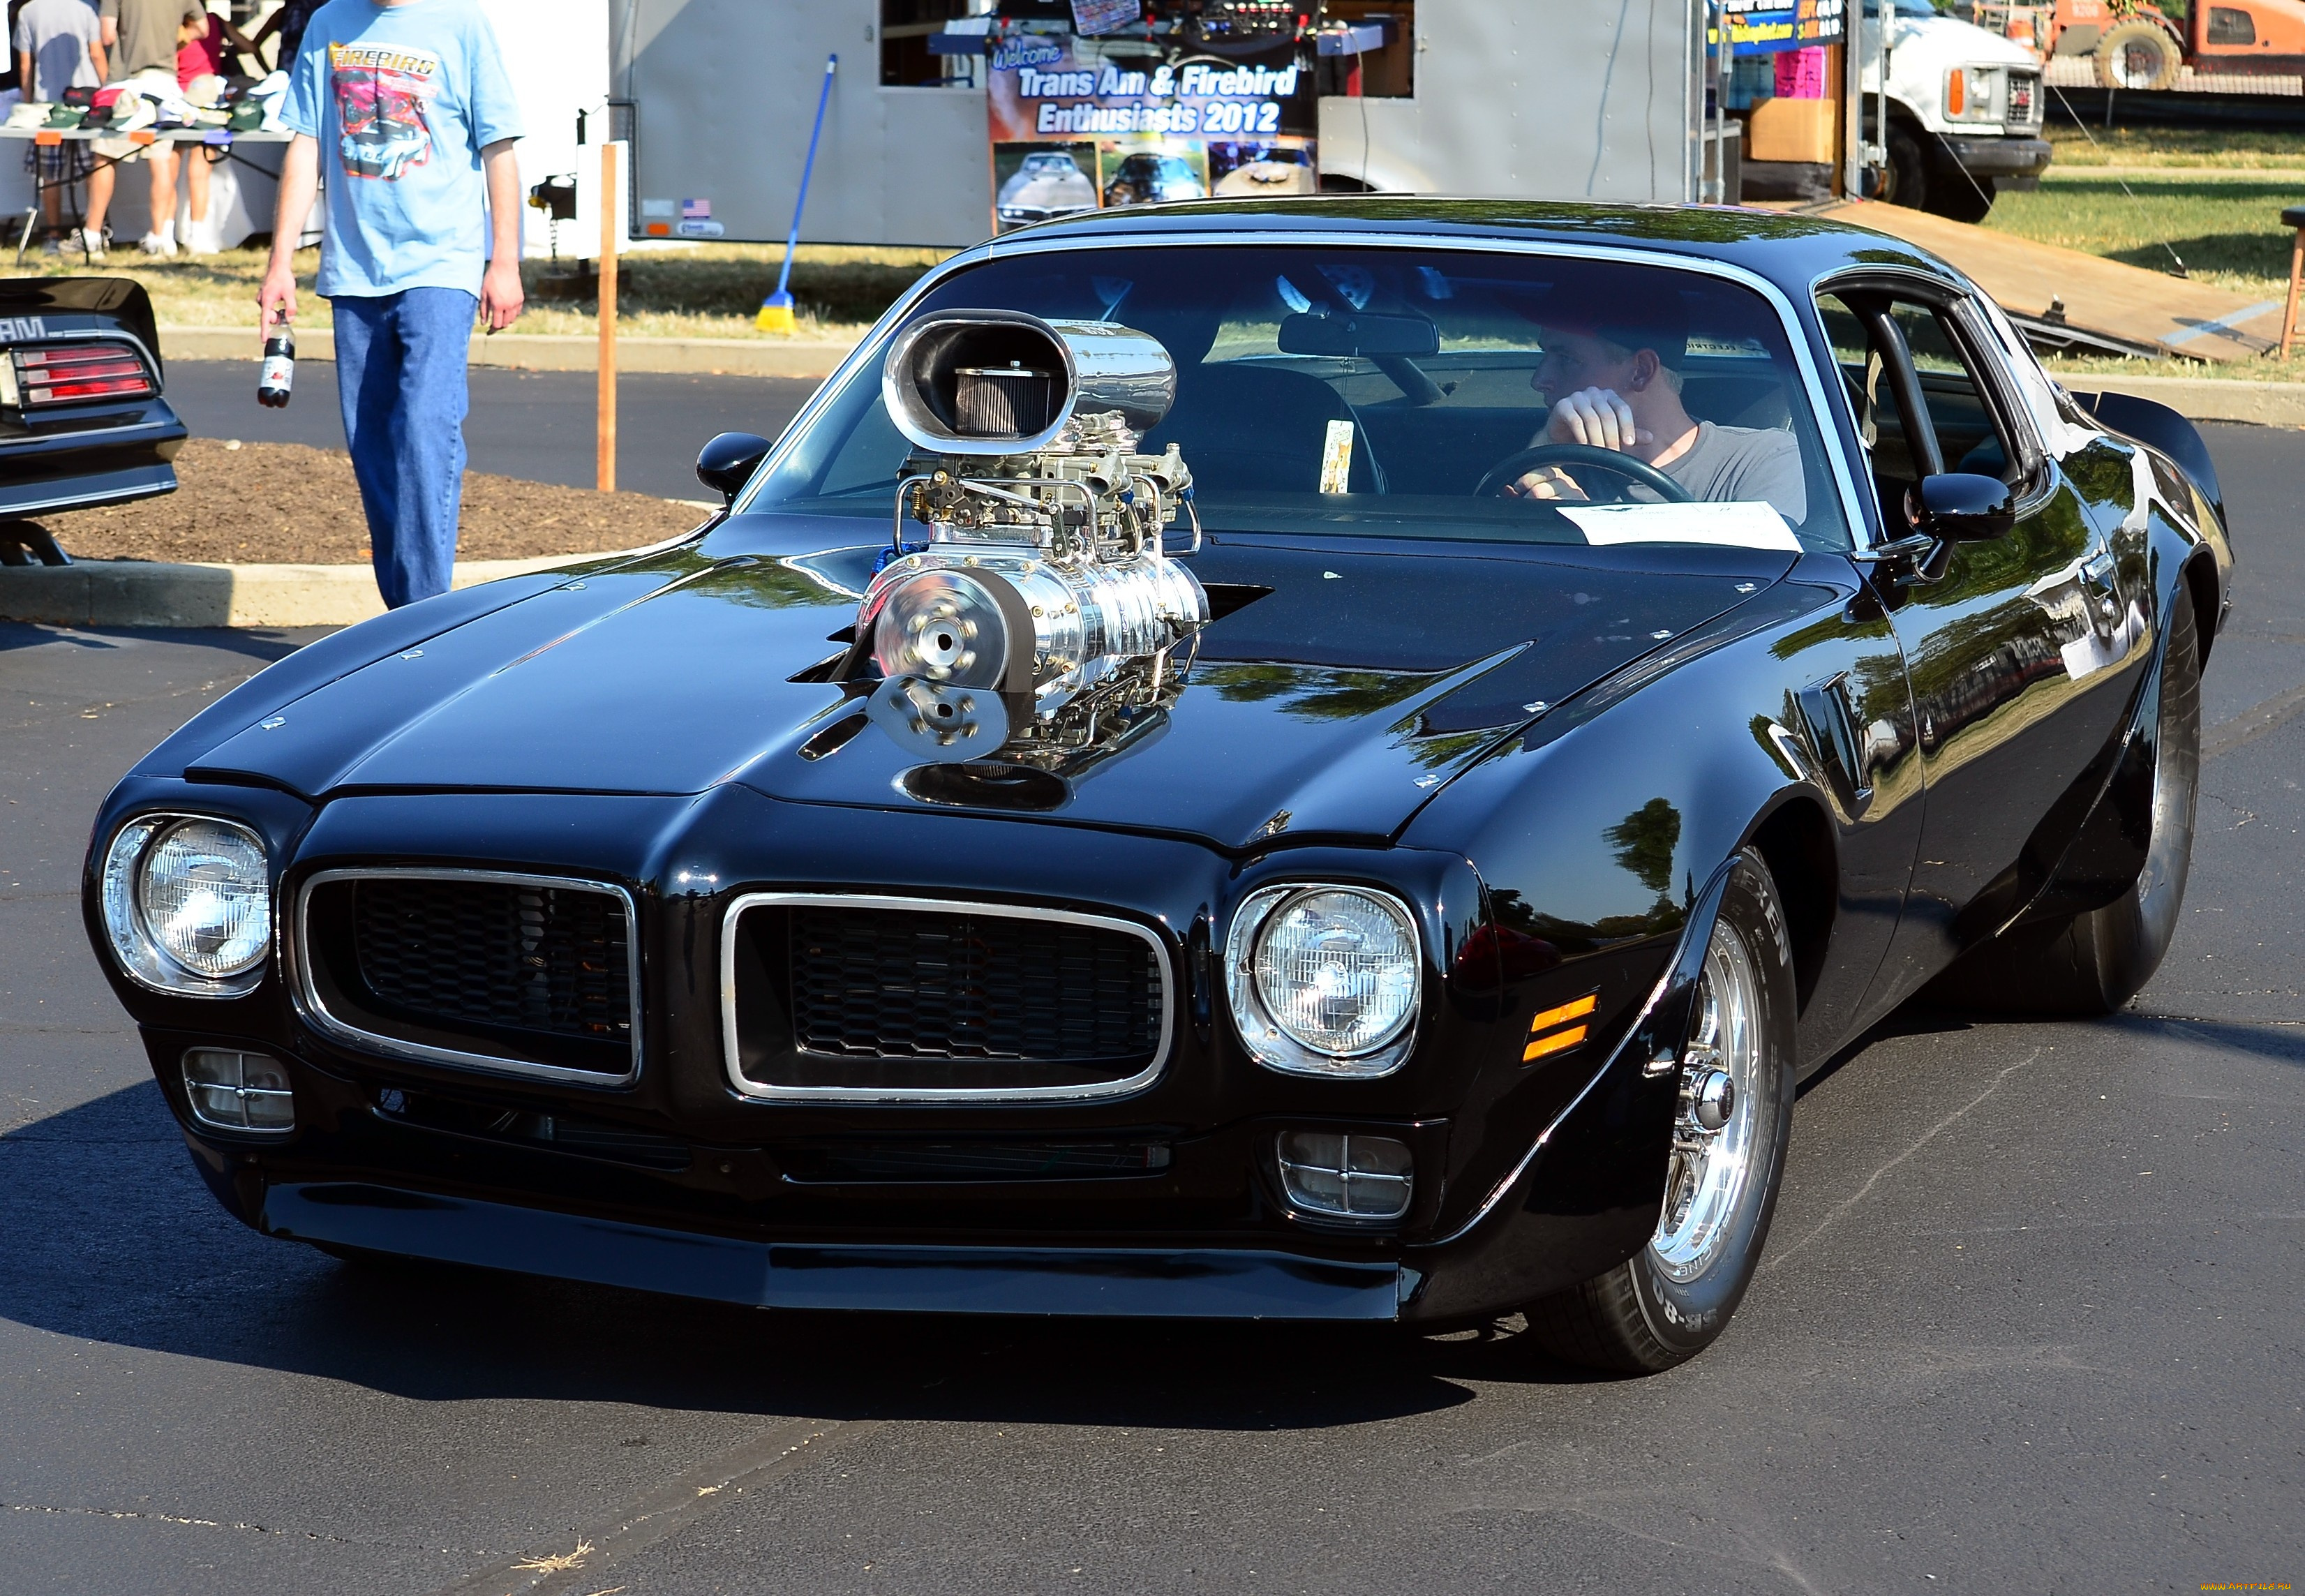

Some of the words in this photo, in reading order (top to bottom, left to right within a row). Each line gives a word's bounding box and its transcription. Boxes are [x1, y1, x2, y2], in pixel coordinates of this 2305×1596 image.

[331, 49, 436, 75] FIREBIRD
[993, 38, 1062, 69] Welcome
[1020, 68, 1094, 96] Trans
[1098, 67, 1144, 96] Am
[1150, 66, 1176, 96] &
[1181, 65, 1297, 96] Firebird
[1038, 101, 1198, 133] Enthusiasts
[1202, 102, 1280, 133] 2012
[0, 316, 46, 342] AM
